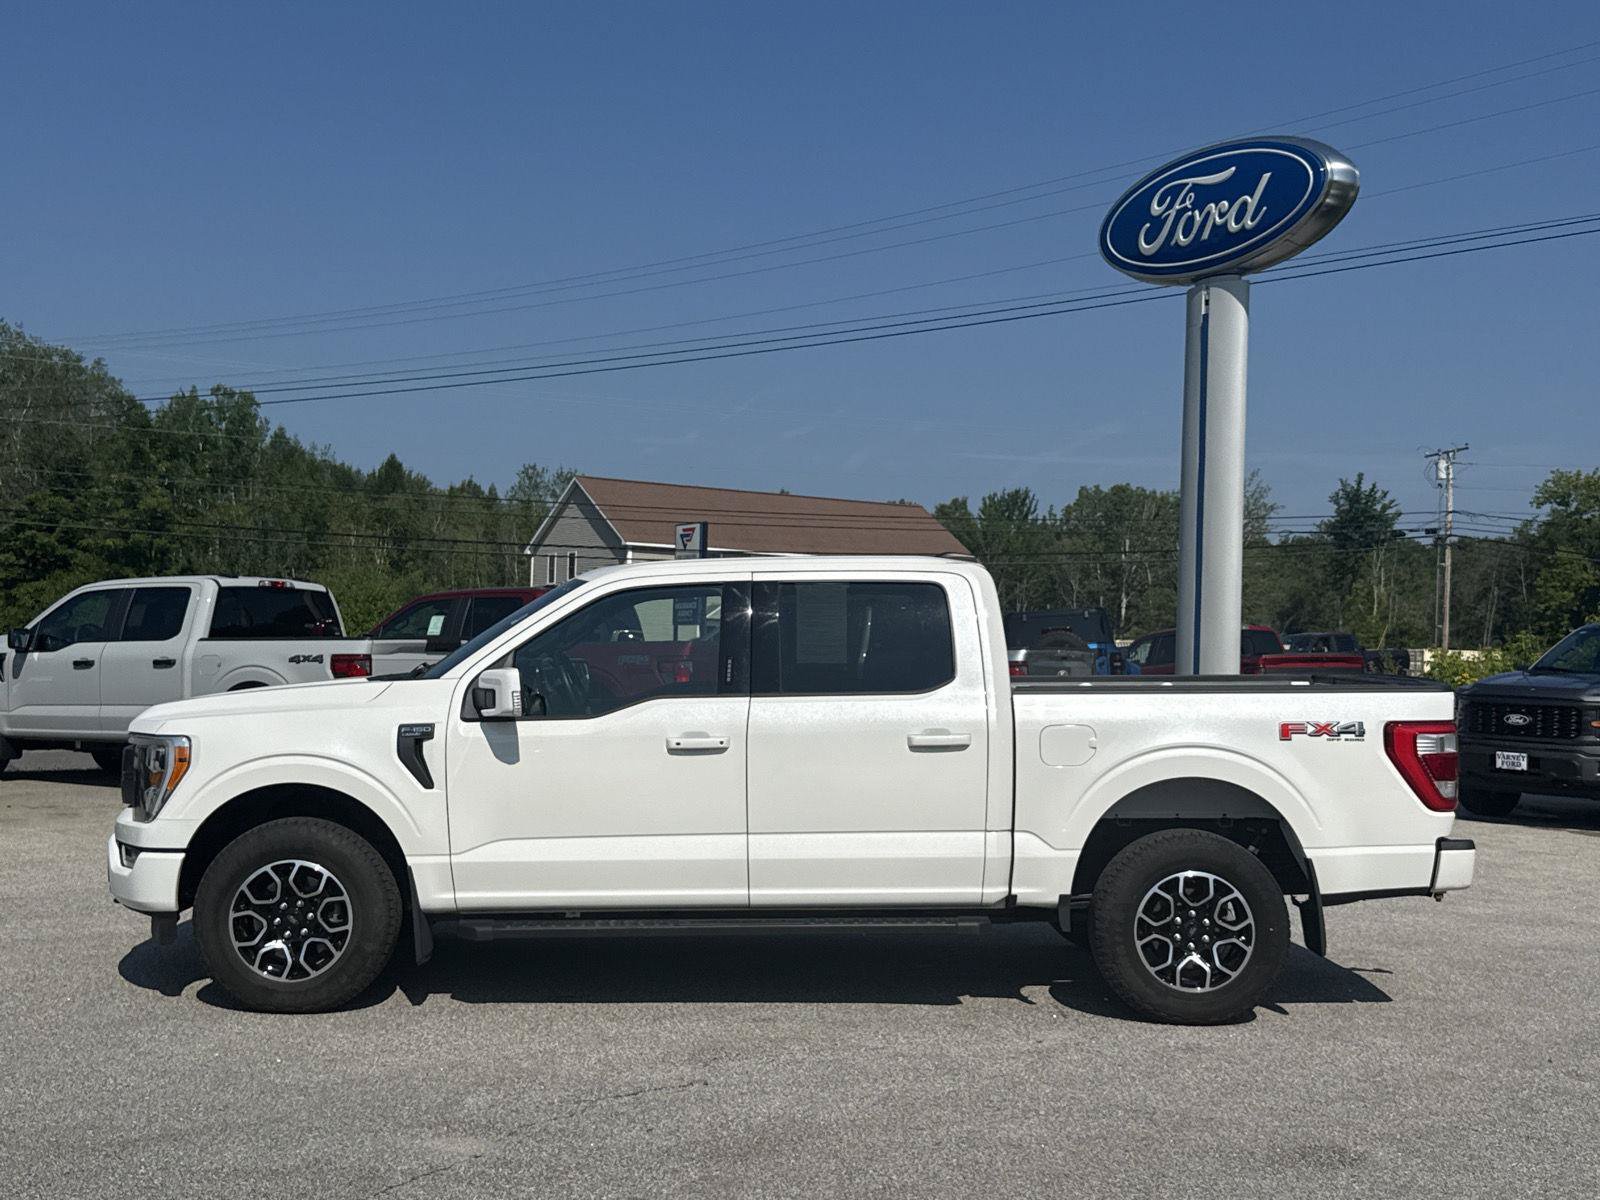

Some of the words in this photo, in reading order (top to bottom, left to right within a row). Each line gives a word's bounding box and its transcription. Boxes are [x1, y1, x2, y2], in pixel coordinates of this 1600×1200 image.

[1138, 166, 1272, 256] Ford
[1279, 721, 1365, 741] FX4
[1497, 752, 1526, 761] VARNEY
[1501, 760, 1522, 768] FORD
